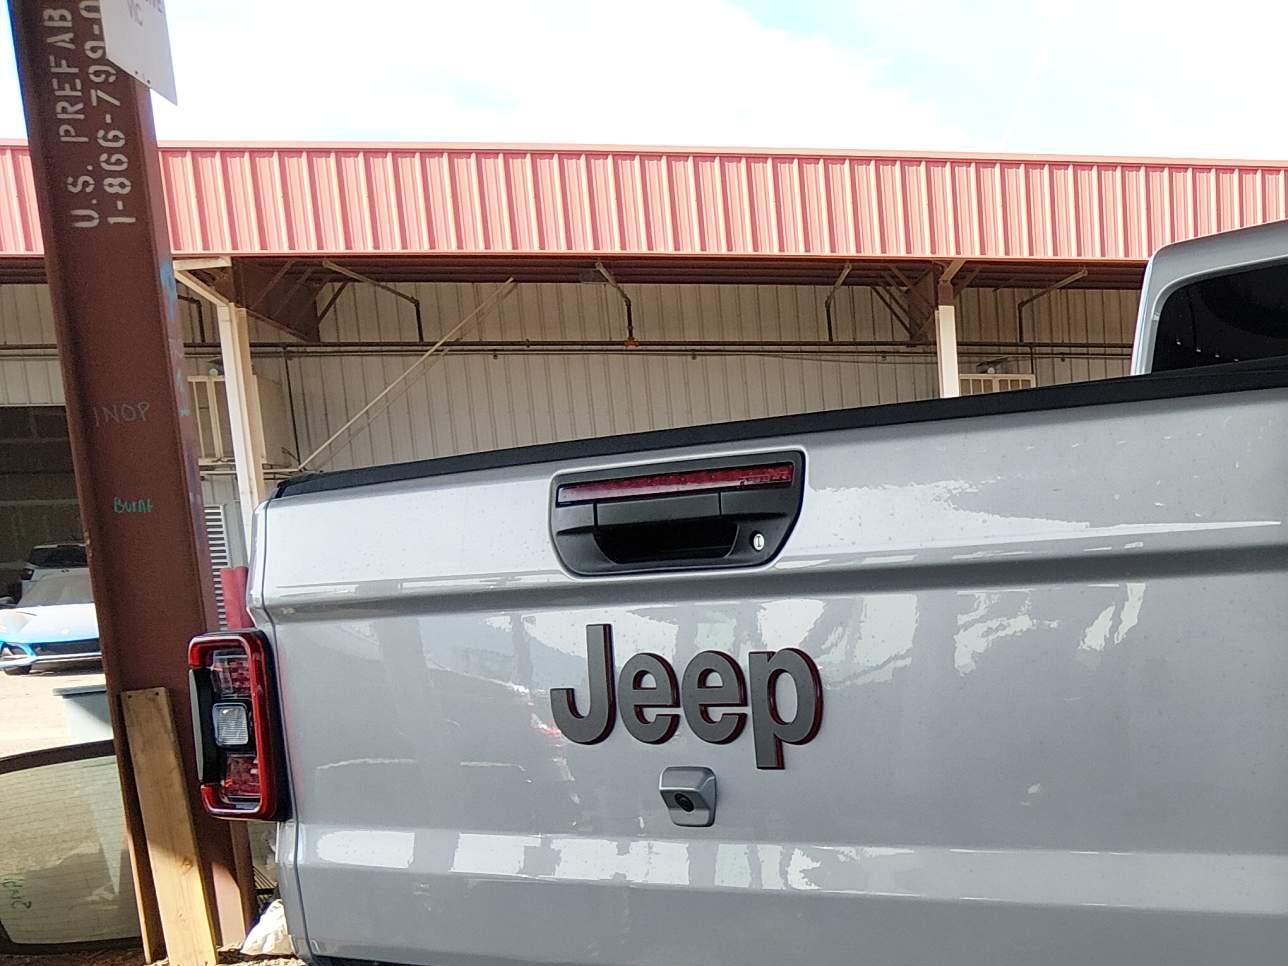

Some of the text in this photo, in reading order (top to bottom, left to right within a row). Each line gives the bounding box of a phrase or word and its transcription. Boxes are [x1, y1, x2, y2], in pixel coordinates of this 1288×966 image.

[44, 7, 100, 229] U.S. PREFAB
[550, 623, 825, 770] Jeep
